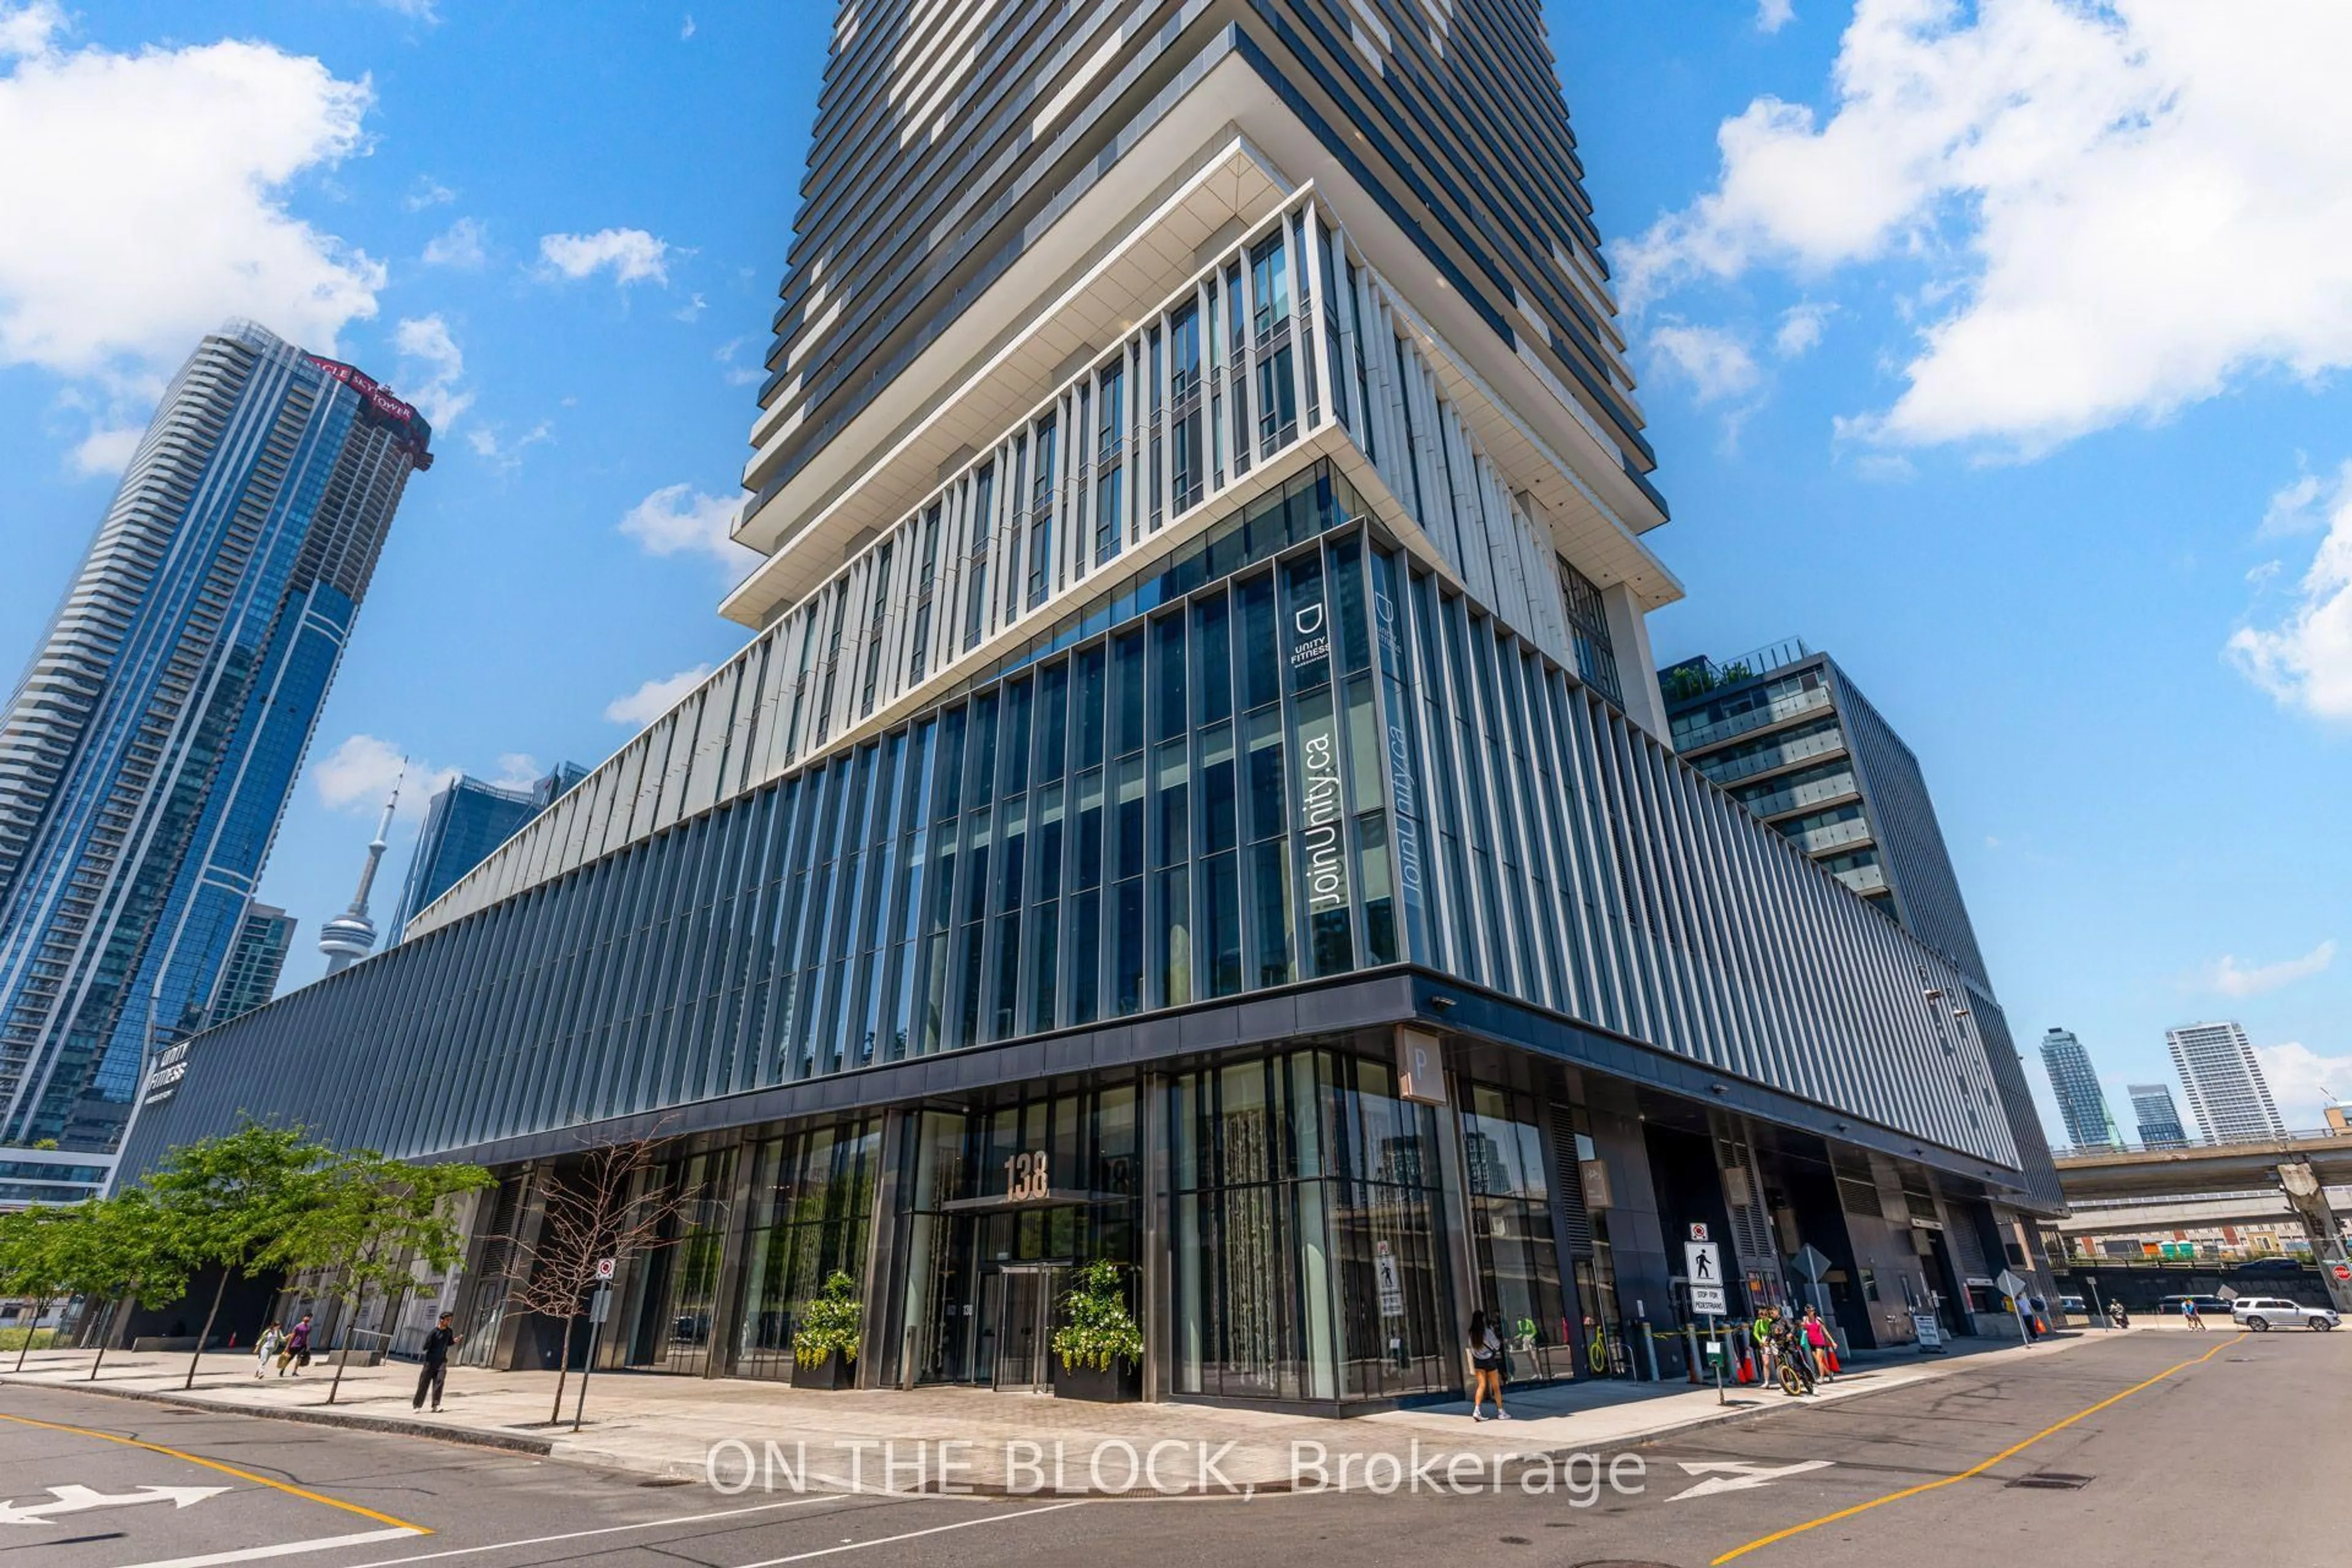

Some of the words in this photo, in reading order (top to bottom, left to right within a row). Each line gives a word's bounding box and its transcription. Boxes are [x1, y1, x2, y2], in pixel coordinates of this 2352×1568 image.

[353, 376, 375, 391] SKY
[372, 394, 410, 418] TOWER
[1291, 643, 1330, 664] FITNESS
[1295, 636, 1325, 654] UNITY
[1302, 733, 1340, 904] JoinUnity.ca
[1414, 1047, 1427, 1080] P
[1005, 1150, 1049, 1202] 138
